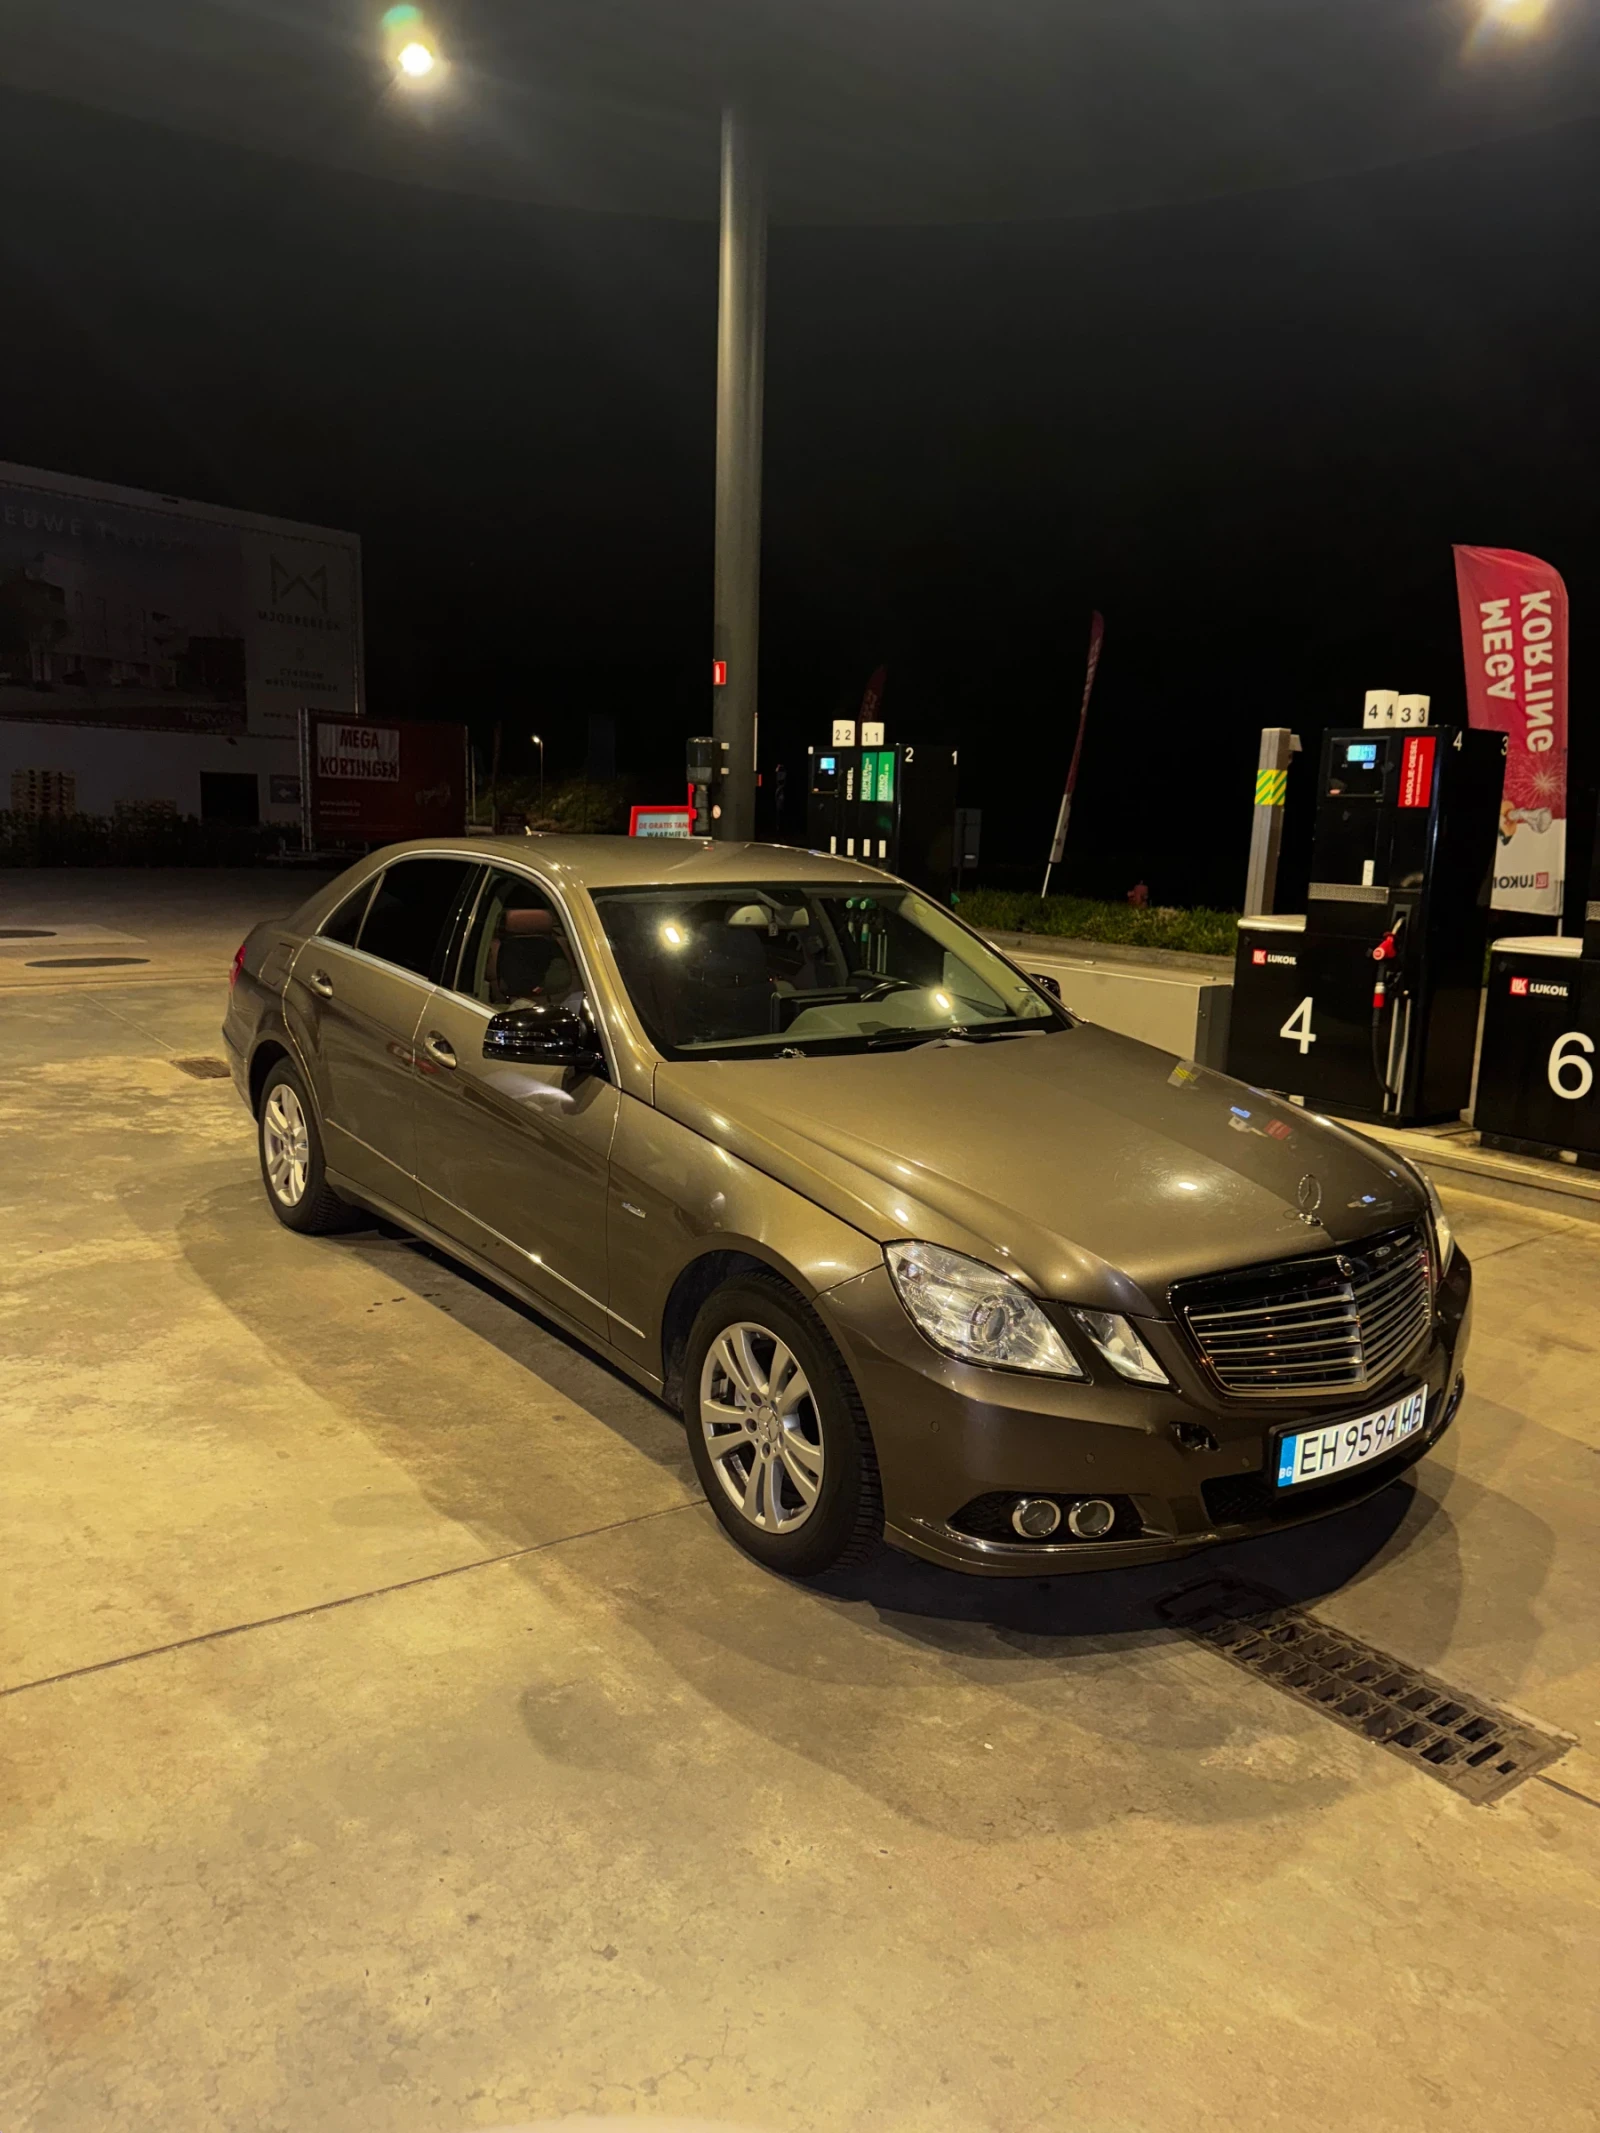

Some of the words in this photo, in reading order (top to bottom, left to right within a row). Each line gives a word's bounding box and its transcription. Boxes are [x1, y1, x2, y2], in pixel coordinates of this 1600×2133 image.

[1368, 704, 1379, 720] 4
[1386, 704, 1394, 720] 4
[1401, 707, 1411, 723] 3
[1418, 707, 1425, 723] 3
[340, 728, 380, 749] MEGA
[835, 729, 841, 741] 2
[845, 729, 852, 741] 2
[1452, 731, 1463, 752] 4
[905, 747, 914, 763] 2
[1501, 735, 1509, 757] 3
[320, 756, 397, 778] KORTINGEN
[951, 750, 958, 766] 1
[846, 767, 854, 801] DIESEL
[1267, 954, 1297, 966] LUKOIL
[1529, 983, 1570, 997] LUKOIL
[1279, 996, 1317, 1055] 4
[1547, 1030, 1596, 1101] 6
[1299, 1430, 1339, 1476] EH
[1344, 1407, 1399, 1463] 9594
[1278, 1467, 1293, 1480] BG
